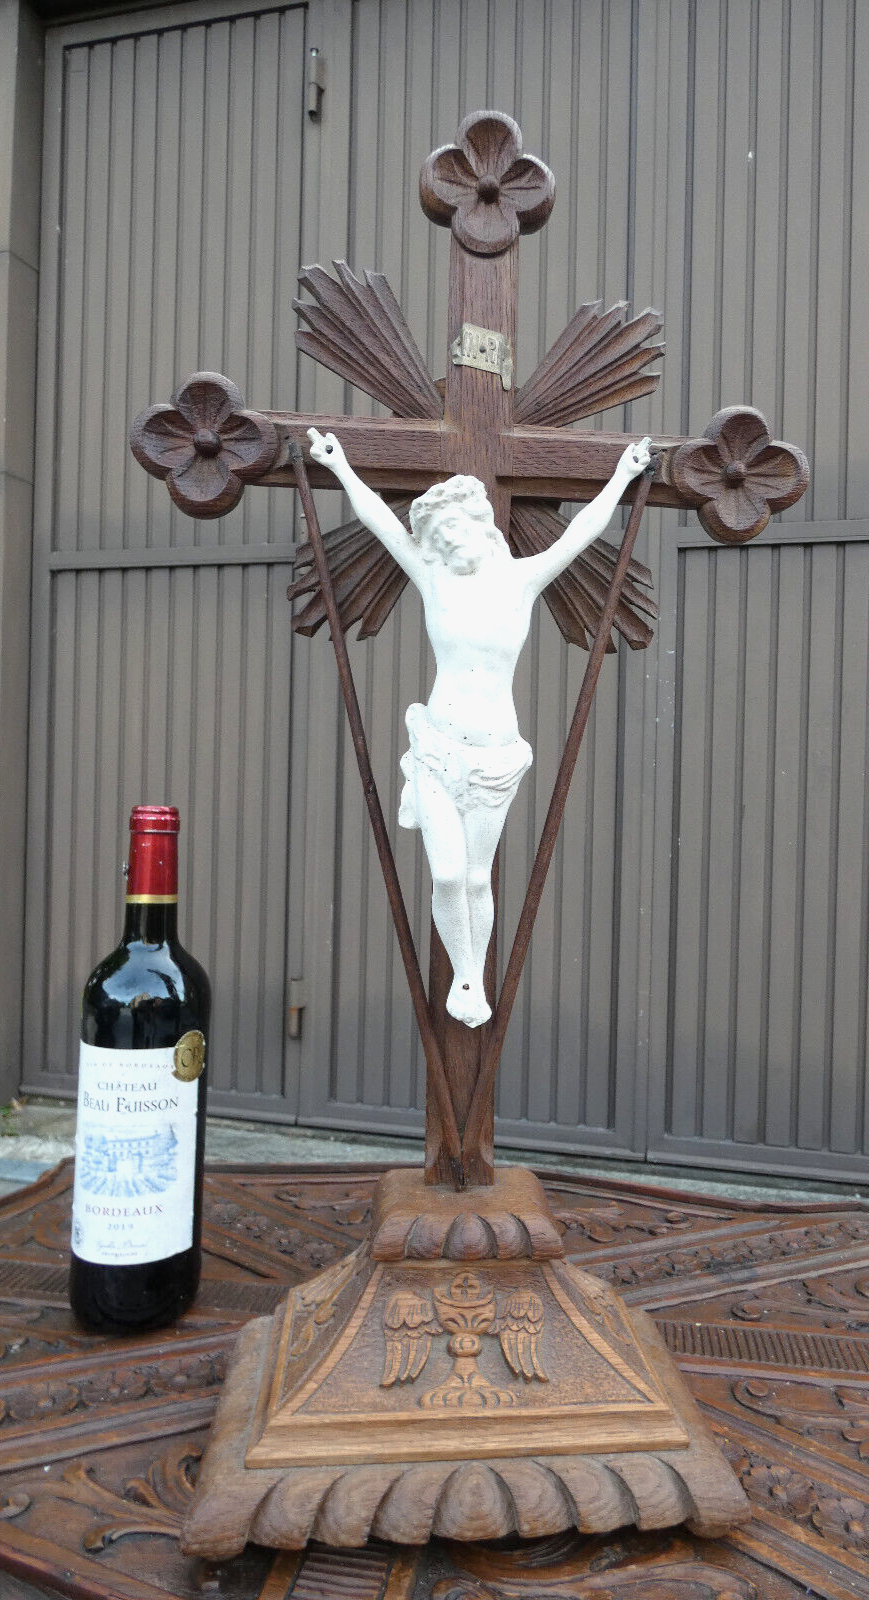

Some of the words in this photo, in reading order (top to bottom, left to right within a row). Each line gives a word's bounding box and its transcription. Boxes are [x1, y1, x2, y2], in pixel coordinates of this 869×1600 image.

[97, 1080, 157, 1092] CHÂTEAU
[83, 1091, 110, 1112] BEAU
[85, 1203, 164, 1217] BORDEAUX
